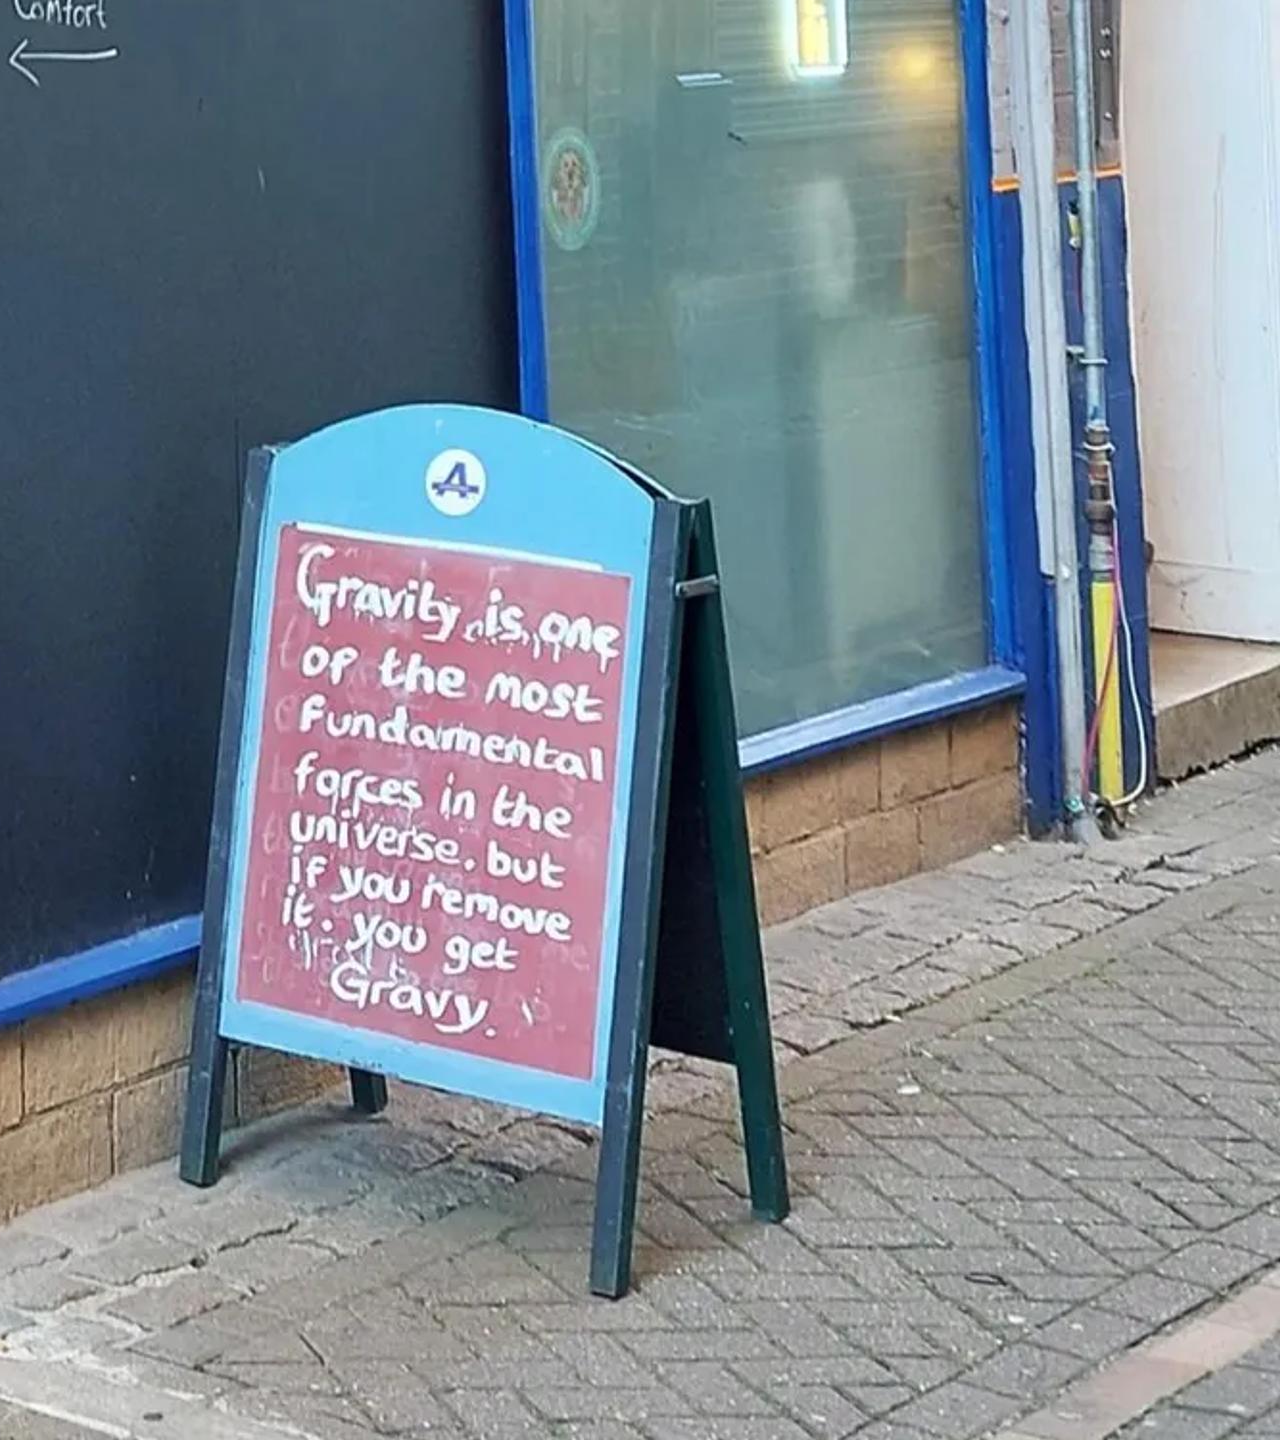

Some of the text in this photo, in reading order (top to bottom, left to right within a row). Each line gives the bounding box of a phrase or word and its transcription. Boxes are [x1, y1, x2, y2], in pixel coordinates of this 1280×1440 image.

[295, 543, 621, 662] Gravity is one
[301, 644, 603, 724] of the most
[299, 694, 604, 782] fundamental
[294, 751, 572, 839] forces in the
[290, 844, 572, 942] if you remove
[486, 840, 567, 890] but
[345, 911, 428, 957] you
[442, 934, 521, 976] get
